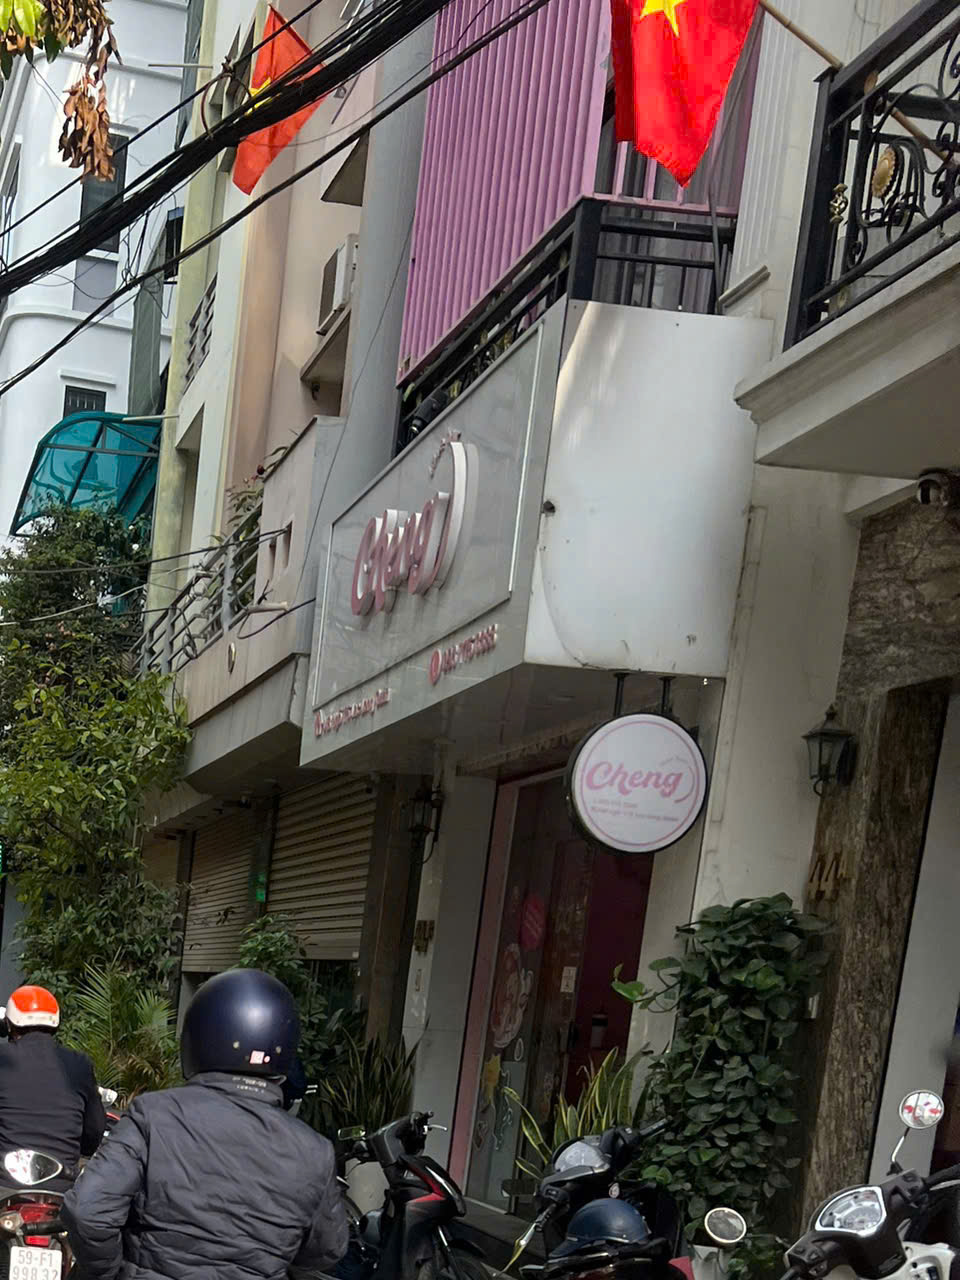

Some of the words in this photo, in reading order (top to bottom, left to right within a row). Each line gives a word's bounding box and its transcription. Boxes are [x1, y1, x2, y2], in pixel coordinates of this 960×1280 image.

[351, 488, 456, 616] Cheng
[585, 761, 683, 798] Cheng
[18, 1249, 54, 1268] 59-F1
